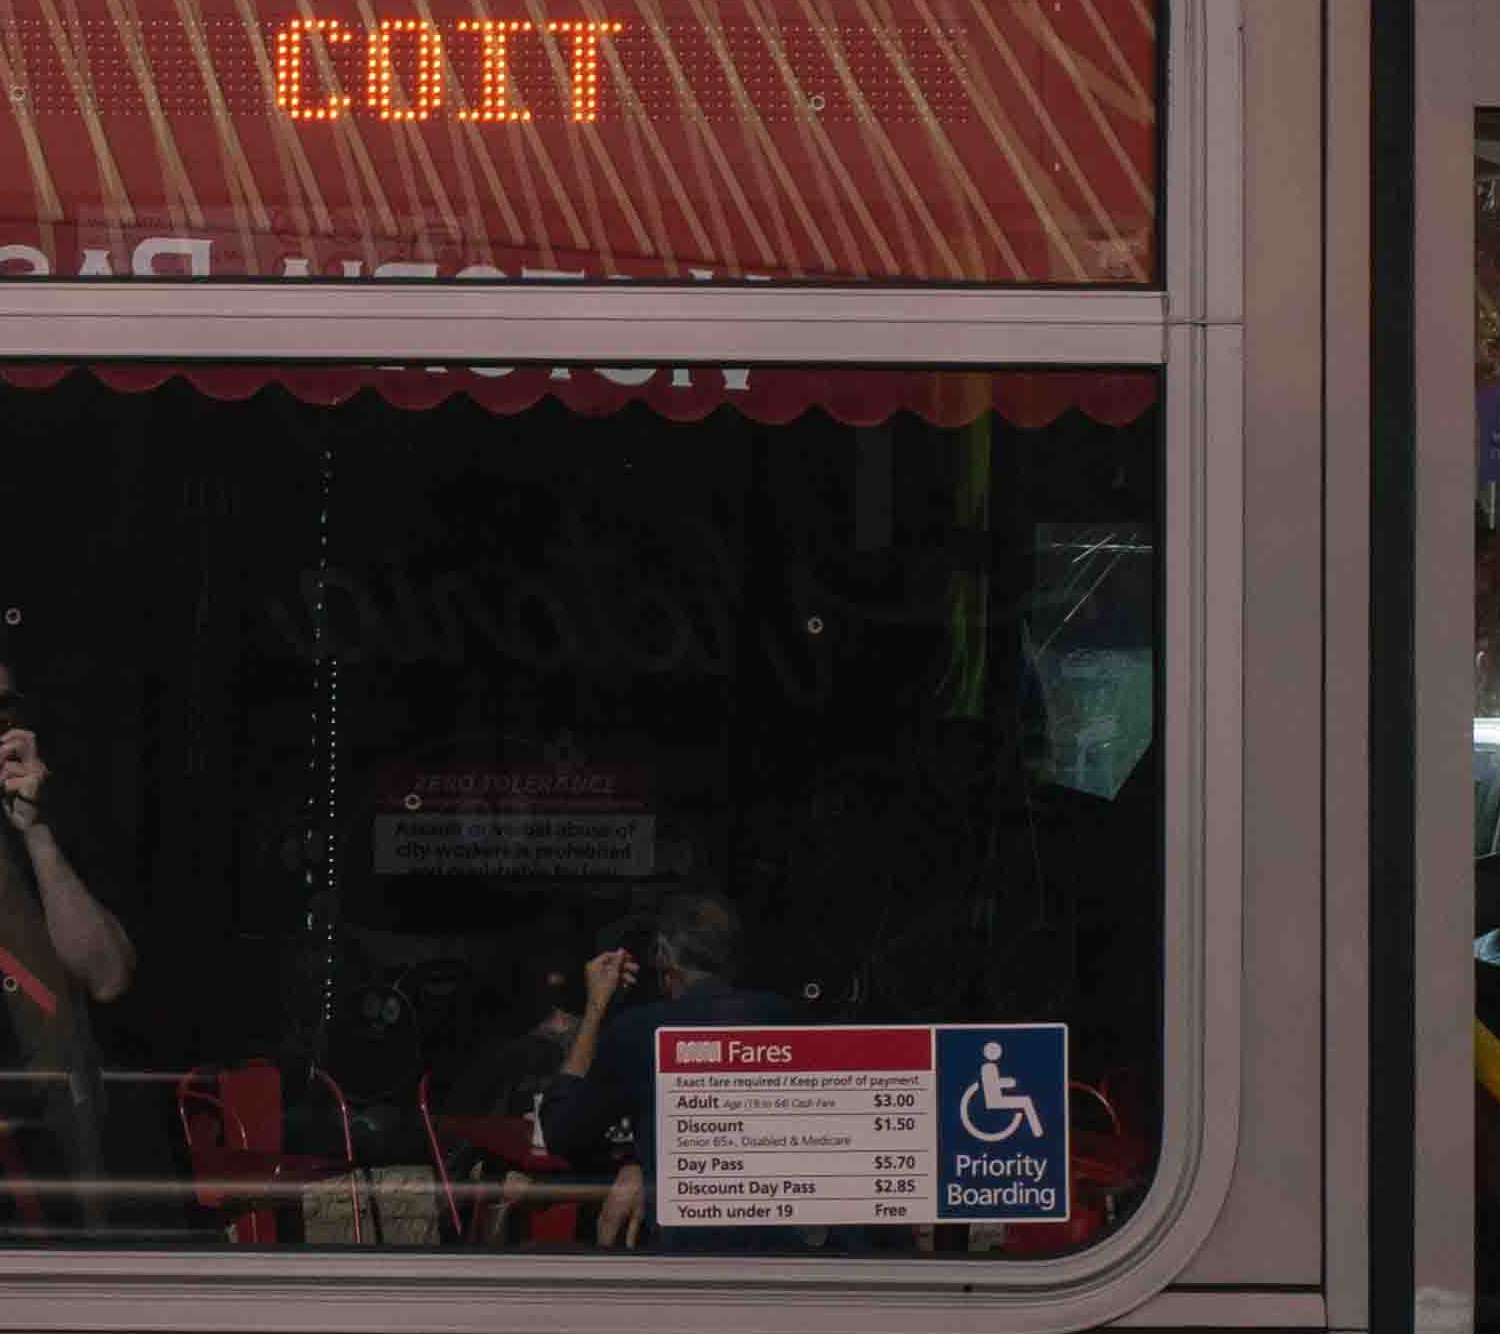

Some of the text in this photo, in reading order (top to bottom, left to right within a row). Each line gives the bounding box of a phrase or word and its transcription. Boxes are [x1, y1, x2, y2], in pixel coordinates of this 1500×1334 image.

[274, 17, 625, 124] COIT
[729, 1041, 792, 1064] Fares
[707, 1077, 730, 1088] fare
[733, 1076, 781, 1089] required
[790, 1075, 818, 1089] Keep
[821, 1075, 851, 1088] proof
[855, 1075, 866, 1086] of
[870, 1075, 919, 1088] payment
[677, 1095, 718, 1109] Adult
[874, 1093, 915, 1108] $3.00
[677, 1117, 915, 1134] Discount $1.50
[677, 1136, 710, 1148] Senior
[741, 1136, 787, 1148] Disabled
[789, 1136, 799, 1147] &
[801, 1135, 851, 1147] Medicare
[677, 1155, 915, 1174] Day Pass $5.70
[955, 1153, 1047, 1182] Priority
[677, 1179, 915, 1197] Discount Day Pass $2.85
[947, 1182, 1056, 1211] Boarding
[677, 1203, 907, 1219] Youth under 19 Free
